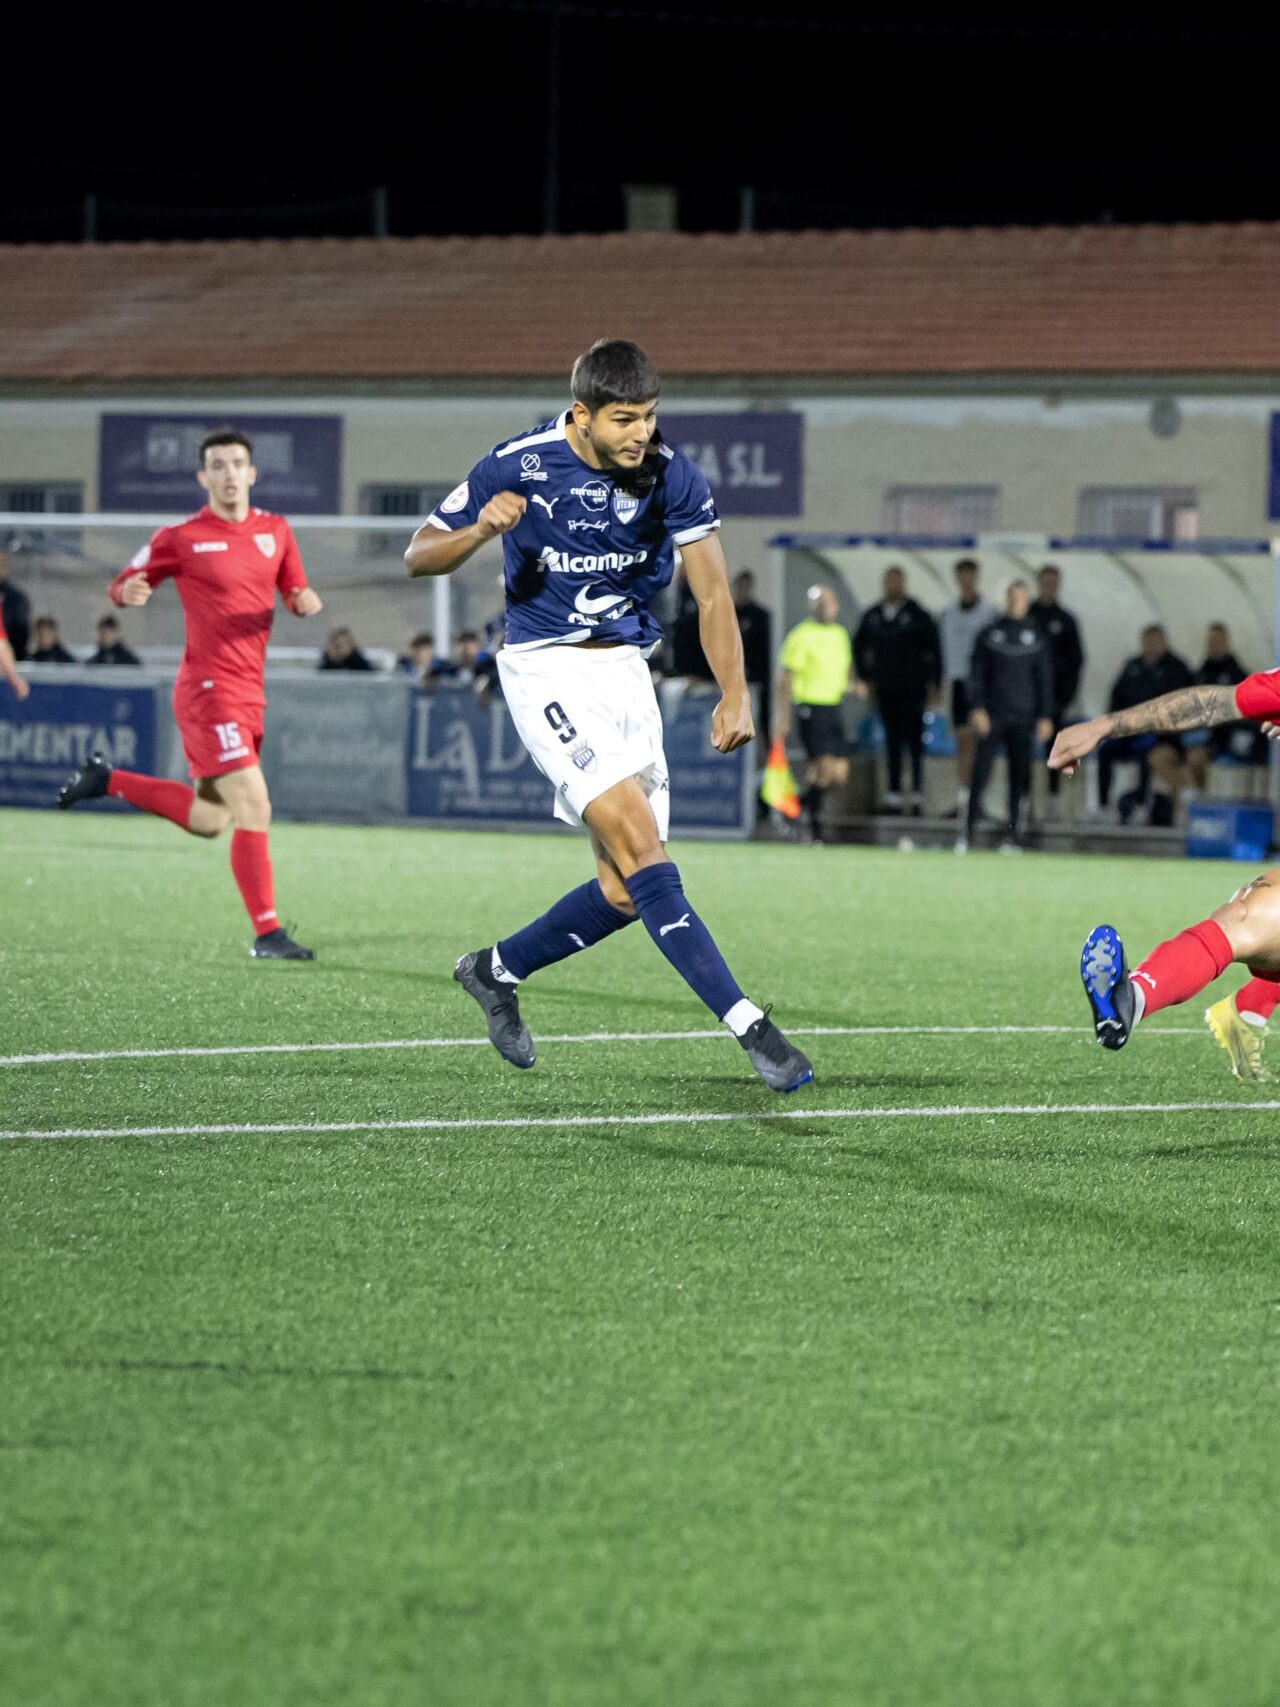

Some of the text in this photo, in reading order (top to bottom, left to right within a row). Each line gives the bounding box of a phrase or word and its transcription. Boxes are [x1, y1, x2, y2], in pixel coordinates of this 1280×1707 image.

[570, 487, 608, 498] euronix
[537, 546, 648, 573] Alcampo
[215, 721, 242, 750] 15
[543, 701, 578, 744] 9
